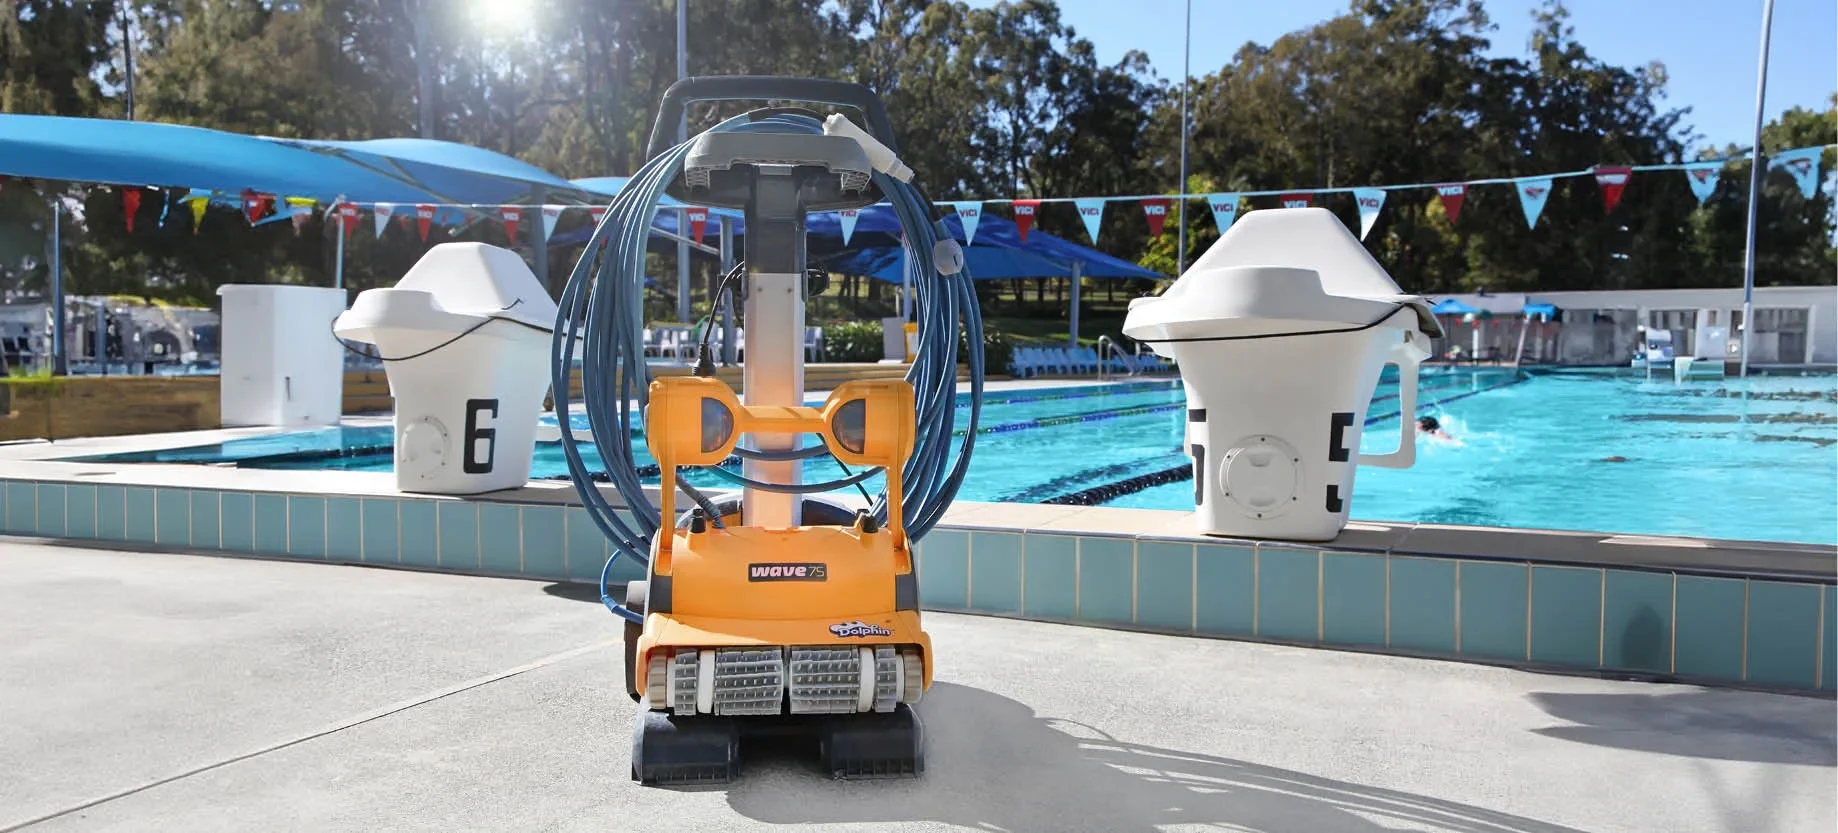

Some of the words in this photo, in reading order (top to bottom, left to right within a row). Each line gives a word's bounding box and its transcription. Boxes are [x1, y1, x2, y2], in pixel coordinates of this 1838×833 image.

[463, 399, 499, 474] 6
[751, 566, 807, 578] wave
[808, 566, 825, 577] 75
[839, 625, 891, 636] Dolphin
